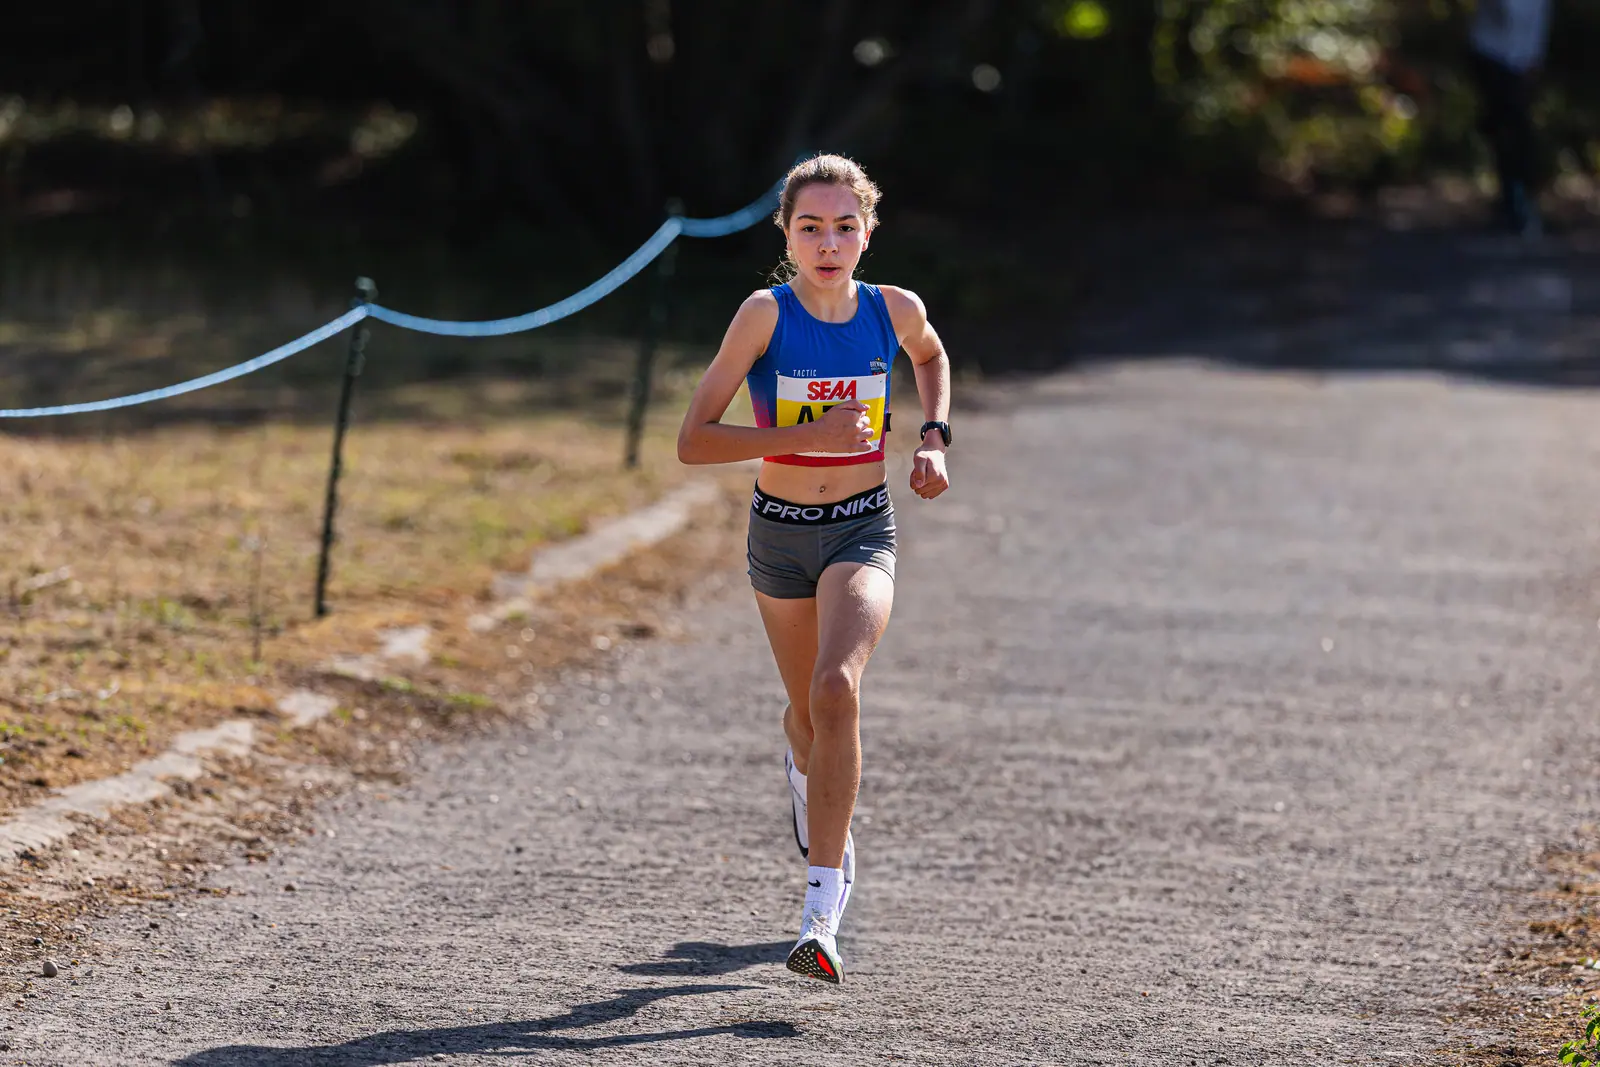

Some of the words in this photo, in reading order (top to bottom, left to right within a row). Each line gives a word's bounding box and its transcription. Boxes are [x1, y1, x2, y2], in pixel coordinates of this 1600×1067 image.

[793, 369, 817, 377] TACTIC
[807, 380, 857, 400] SEAA
[762, 501, 824, 521] PRO
[831, 488, 888, 519] NIKE
